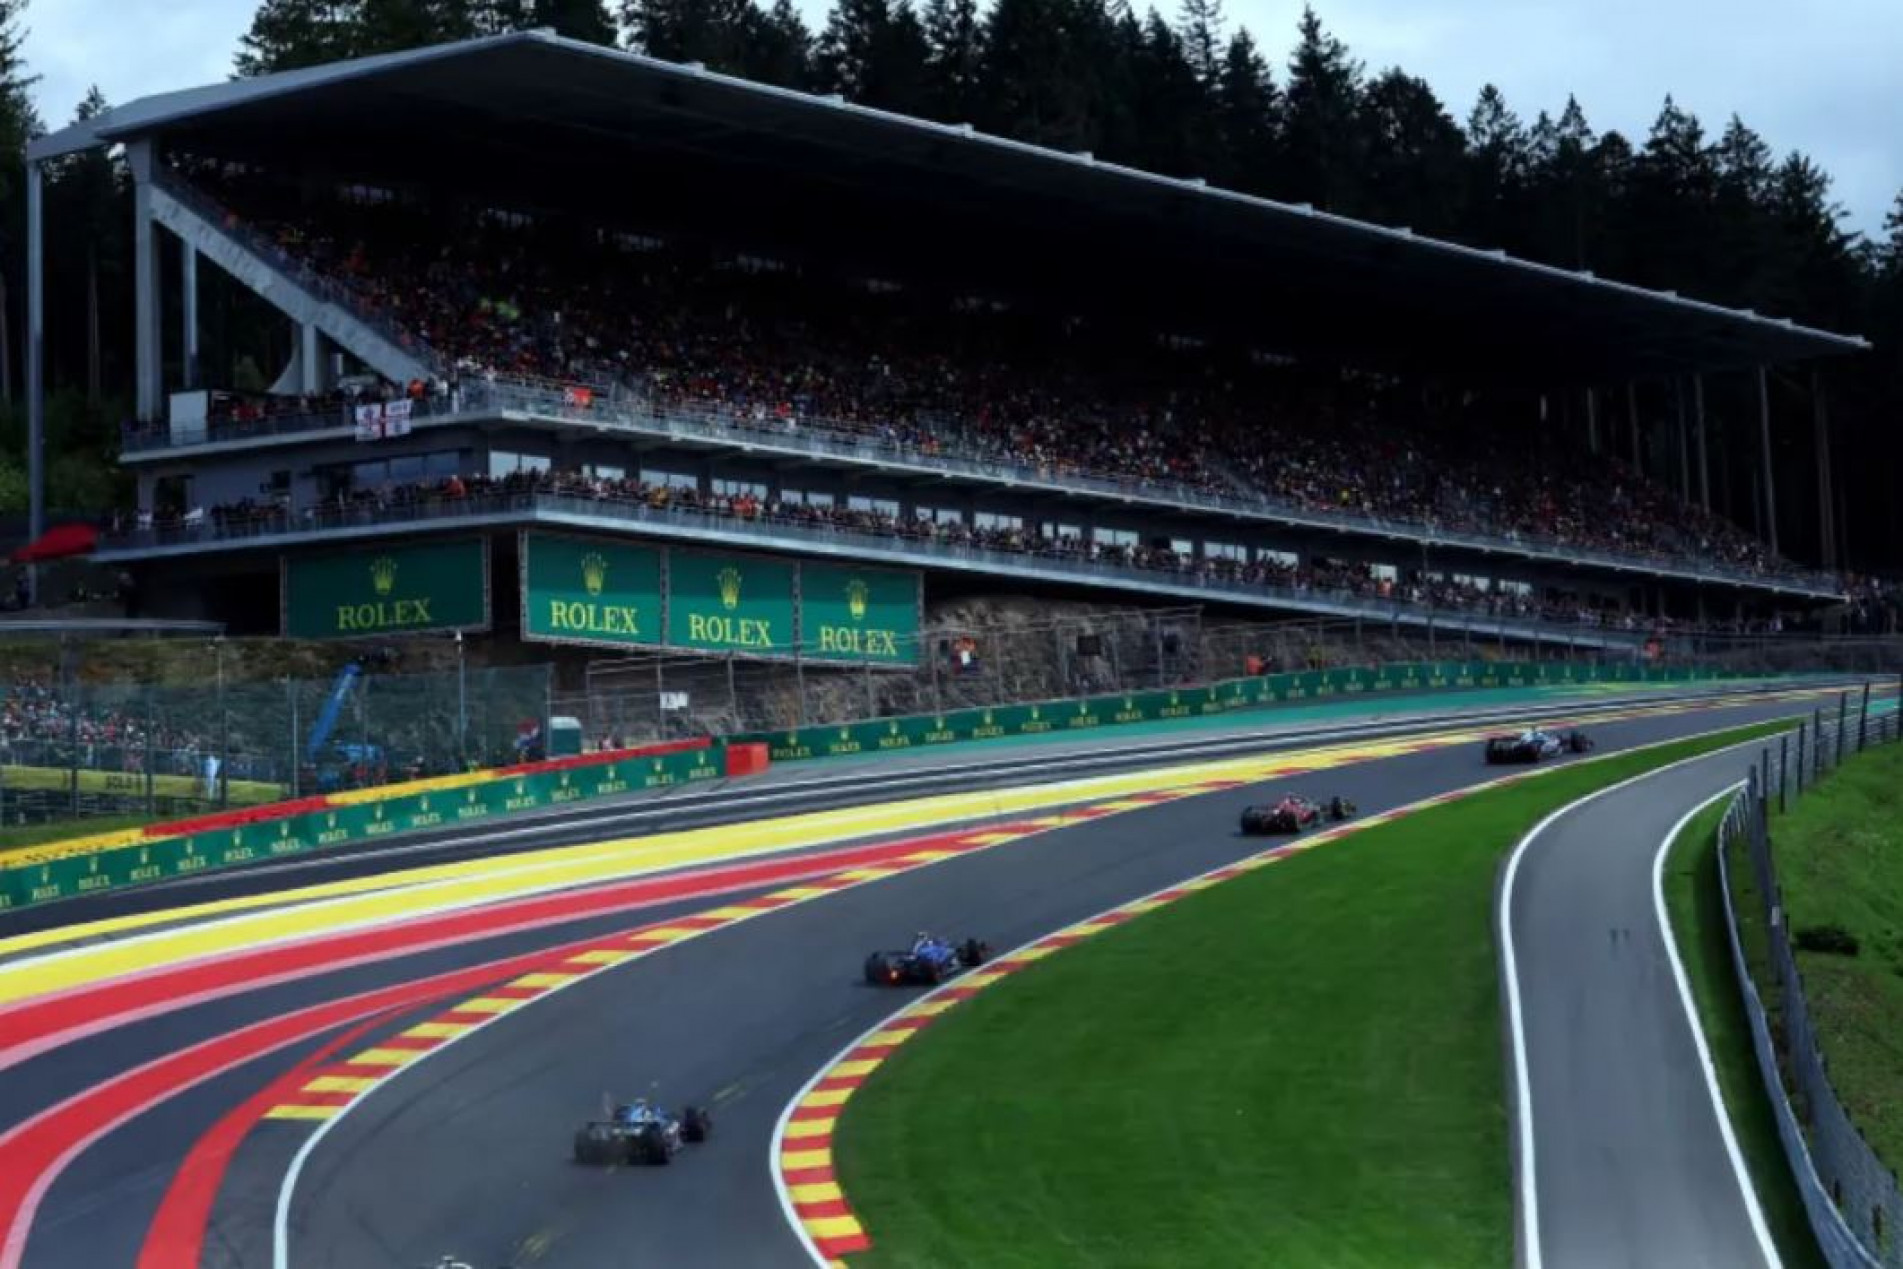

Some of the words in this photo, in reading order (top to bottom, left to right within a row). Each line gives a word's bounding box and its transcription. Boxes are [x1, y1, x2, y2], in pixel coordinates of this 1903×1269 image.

[338, 598, 431, 630] ROLEX
[550, 600, 638, 634] ROLEX
[688, 613, 773, 647] ROLEX
[820, 626, 897, 656] ROLEX
